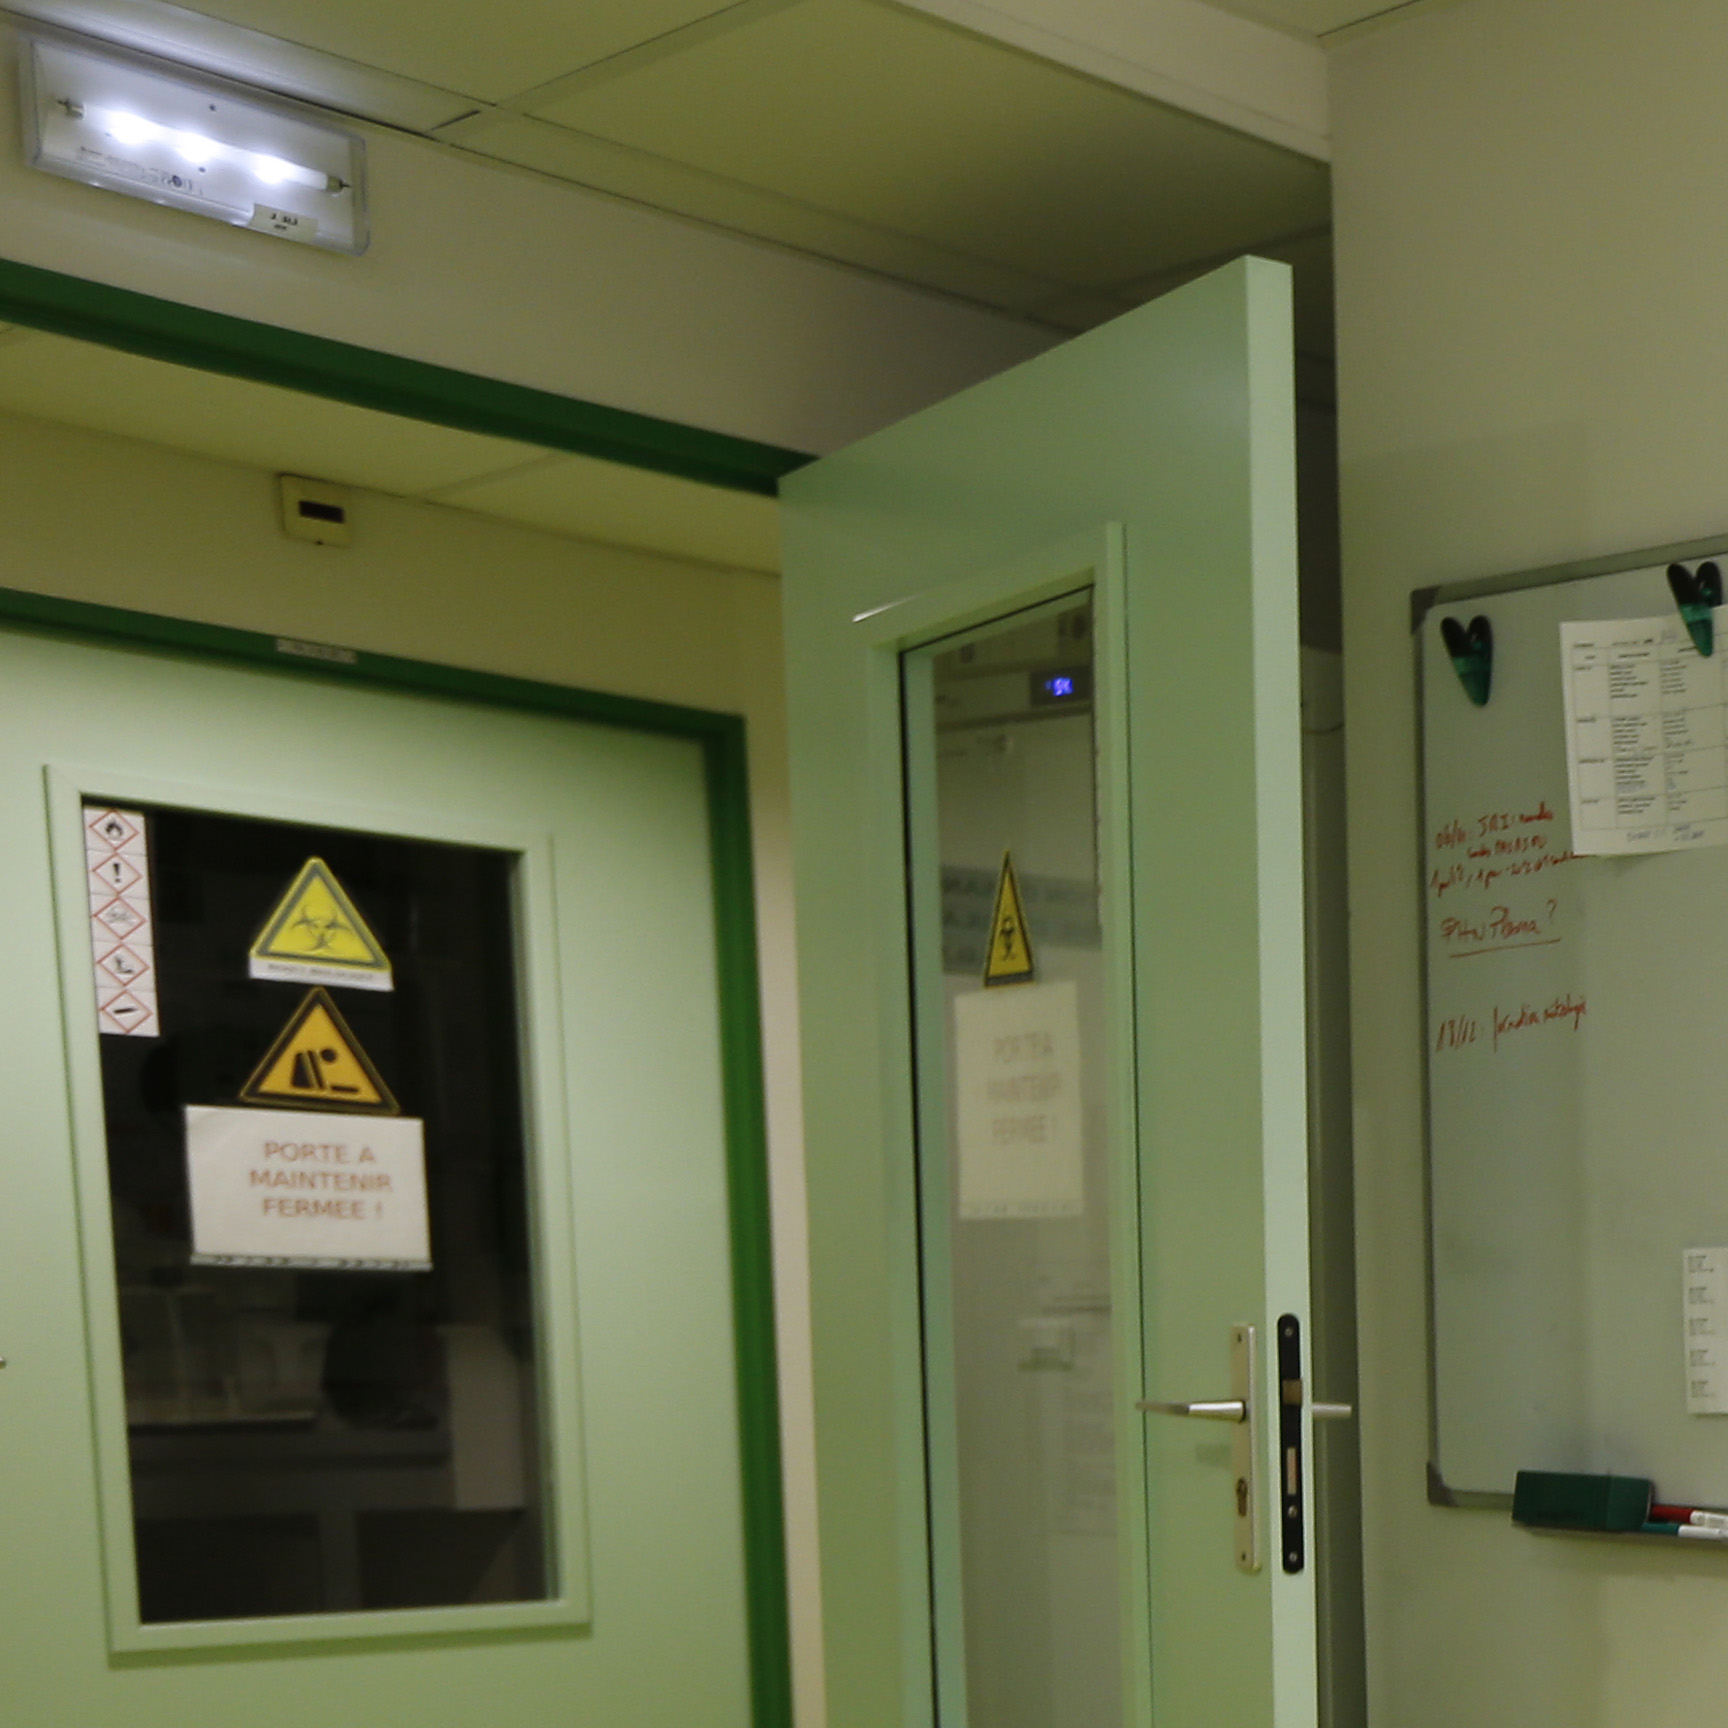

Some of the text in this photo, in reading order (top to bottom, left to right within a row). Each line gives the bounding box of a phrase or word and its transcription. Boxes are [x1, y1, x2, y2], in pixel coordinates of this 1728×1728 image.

[263, 1141, 377, 1164] PORTE A
[249, 1168, 394, 1194] MAINTENIR
[262, 1198, 367, 1220] FERMEE
